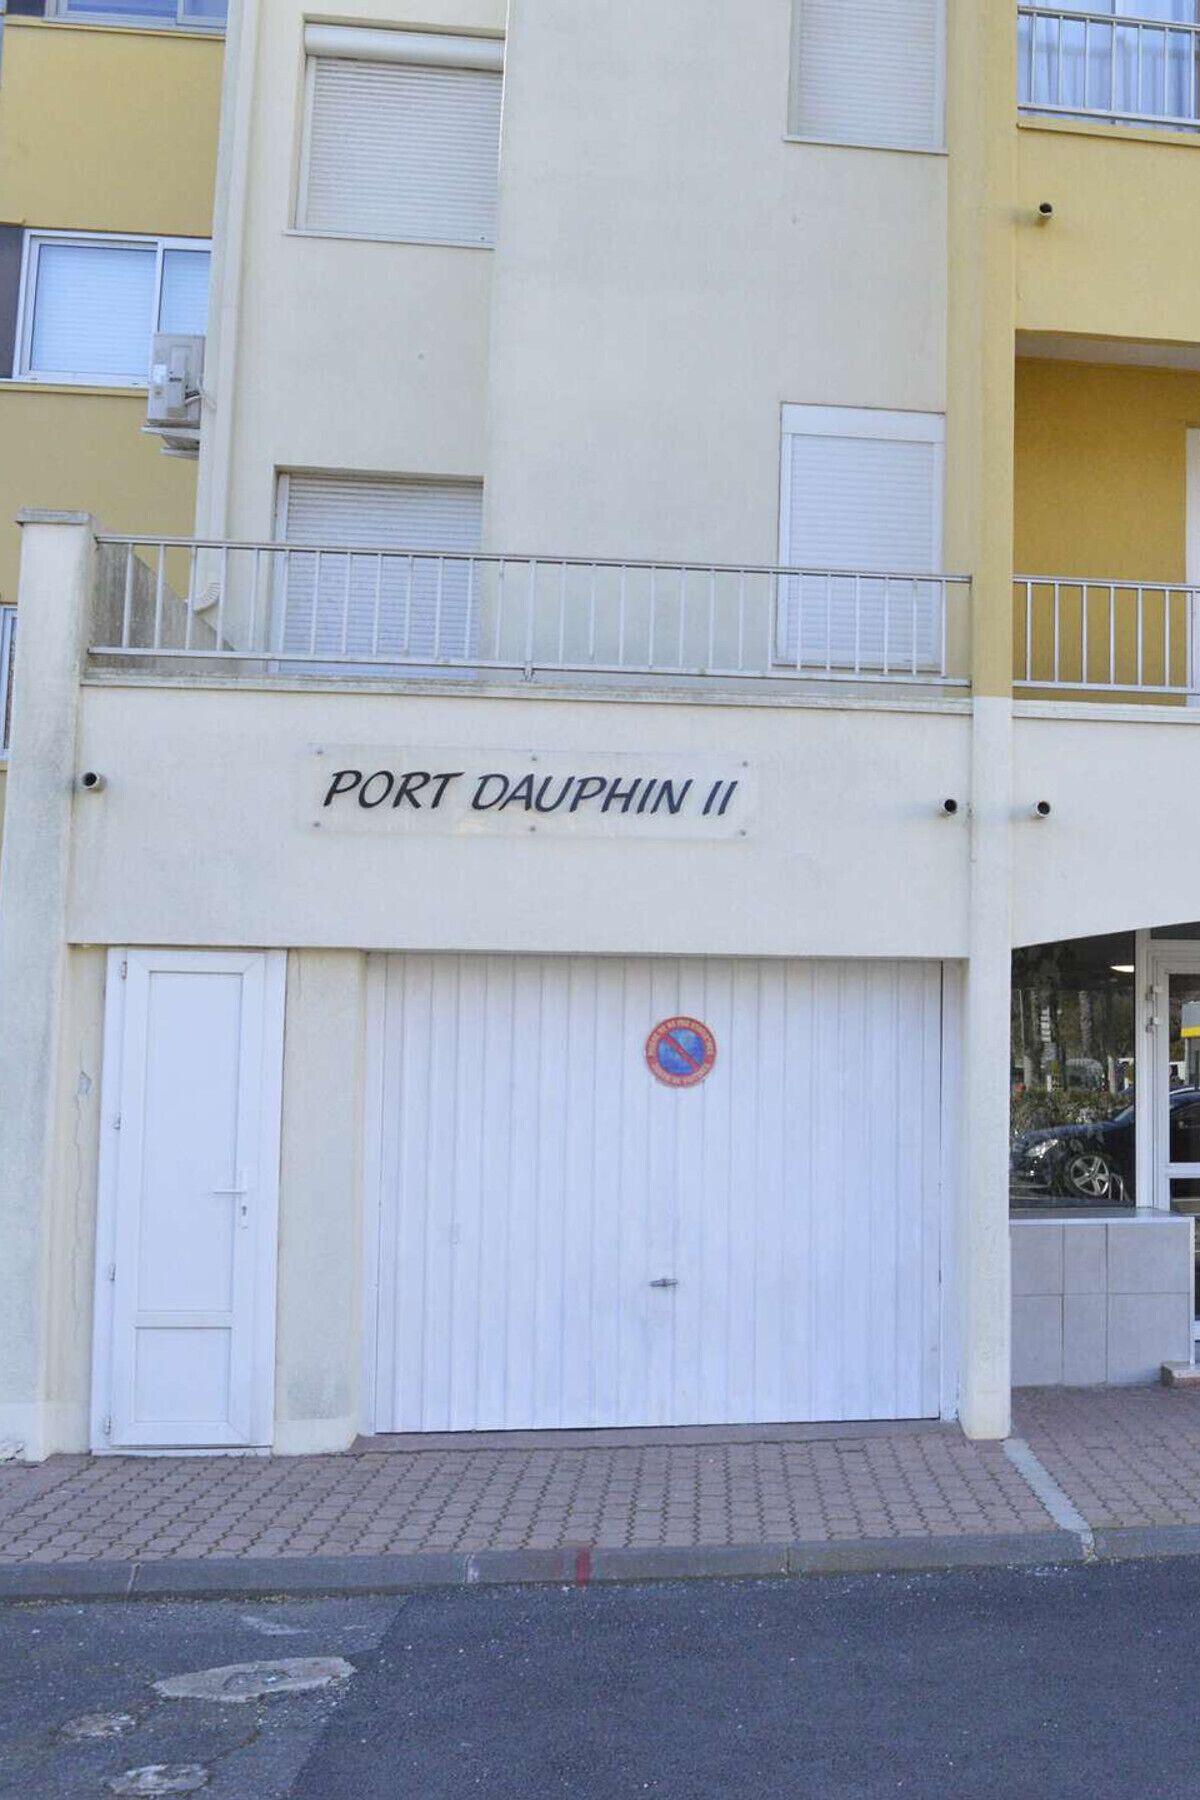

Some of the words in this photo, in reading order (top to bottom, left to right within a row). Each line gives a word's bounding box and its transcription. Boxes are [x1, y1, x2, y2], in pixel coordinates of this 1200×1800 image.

[323, 769, 465, 810] PORT
[471, 773, 693, 815] DAUPHIN
[701, 780, 739, 816] II
